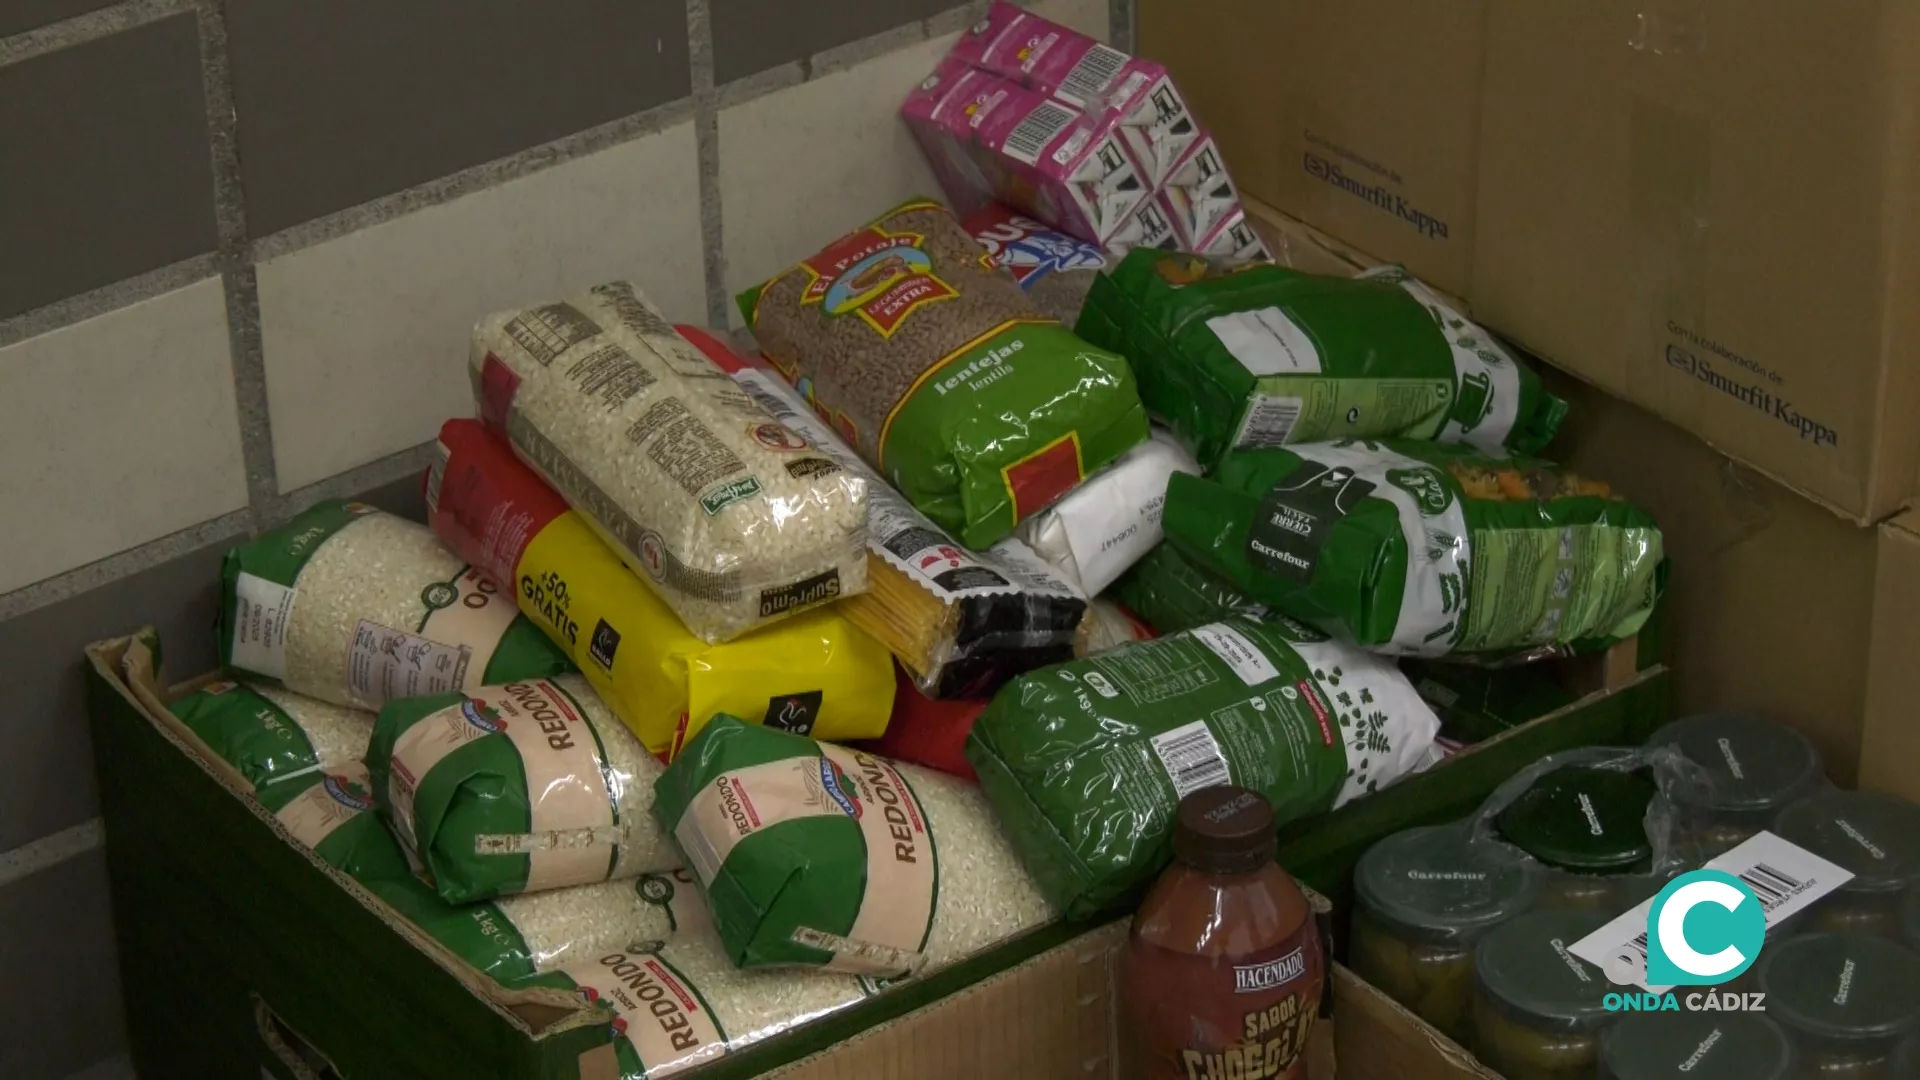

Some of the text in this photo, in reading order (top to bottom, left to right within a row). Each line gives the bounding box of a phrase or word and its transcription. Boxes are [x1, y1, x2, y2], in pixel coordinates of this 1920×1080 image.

[1330, 166, 1448, 240] Smurfit Kappa
[884, 285, 932, 316] EXTRA
[934, 337, 1025, 396] lentejas
[1696, 361, 1838, 447] Smurfit Kappa
[1250, 539, 1311, 570] Carrefour
[521, 574, 579, 646] GRATIS
[762, 580, 839, 615] Supremo
[506, 681, 575, 751] REDOND
[856, 753, 916, 863] REDOND
[1407, 869, 1487, 882] Carrefour
[1236, 952, 1303, 988] HACENDADO
[602, 953, 698, 1052] REDONDO
[1246, 998, 1297, 1038] SABOR
[1677, 1028, 1722, 1071] Carrefour
